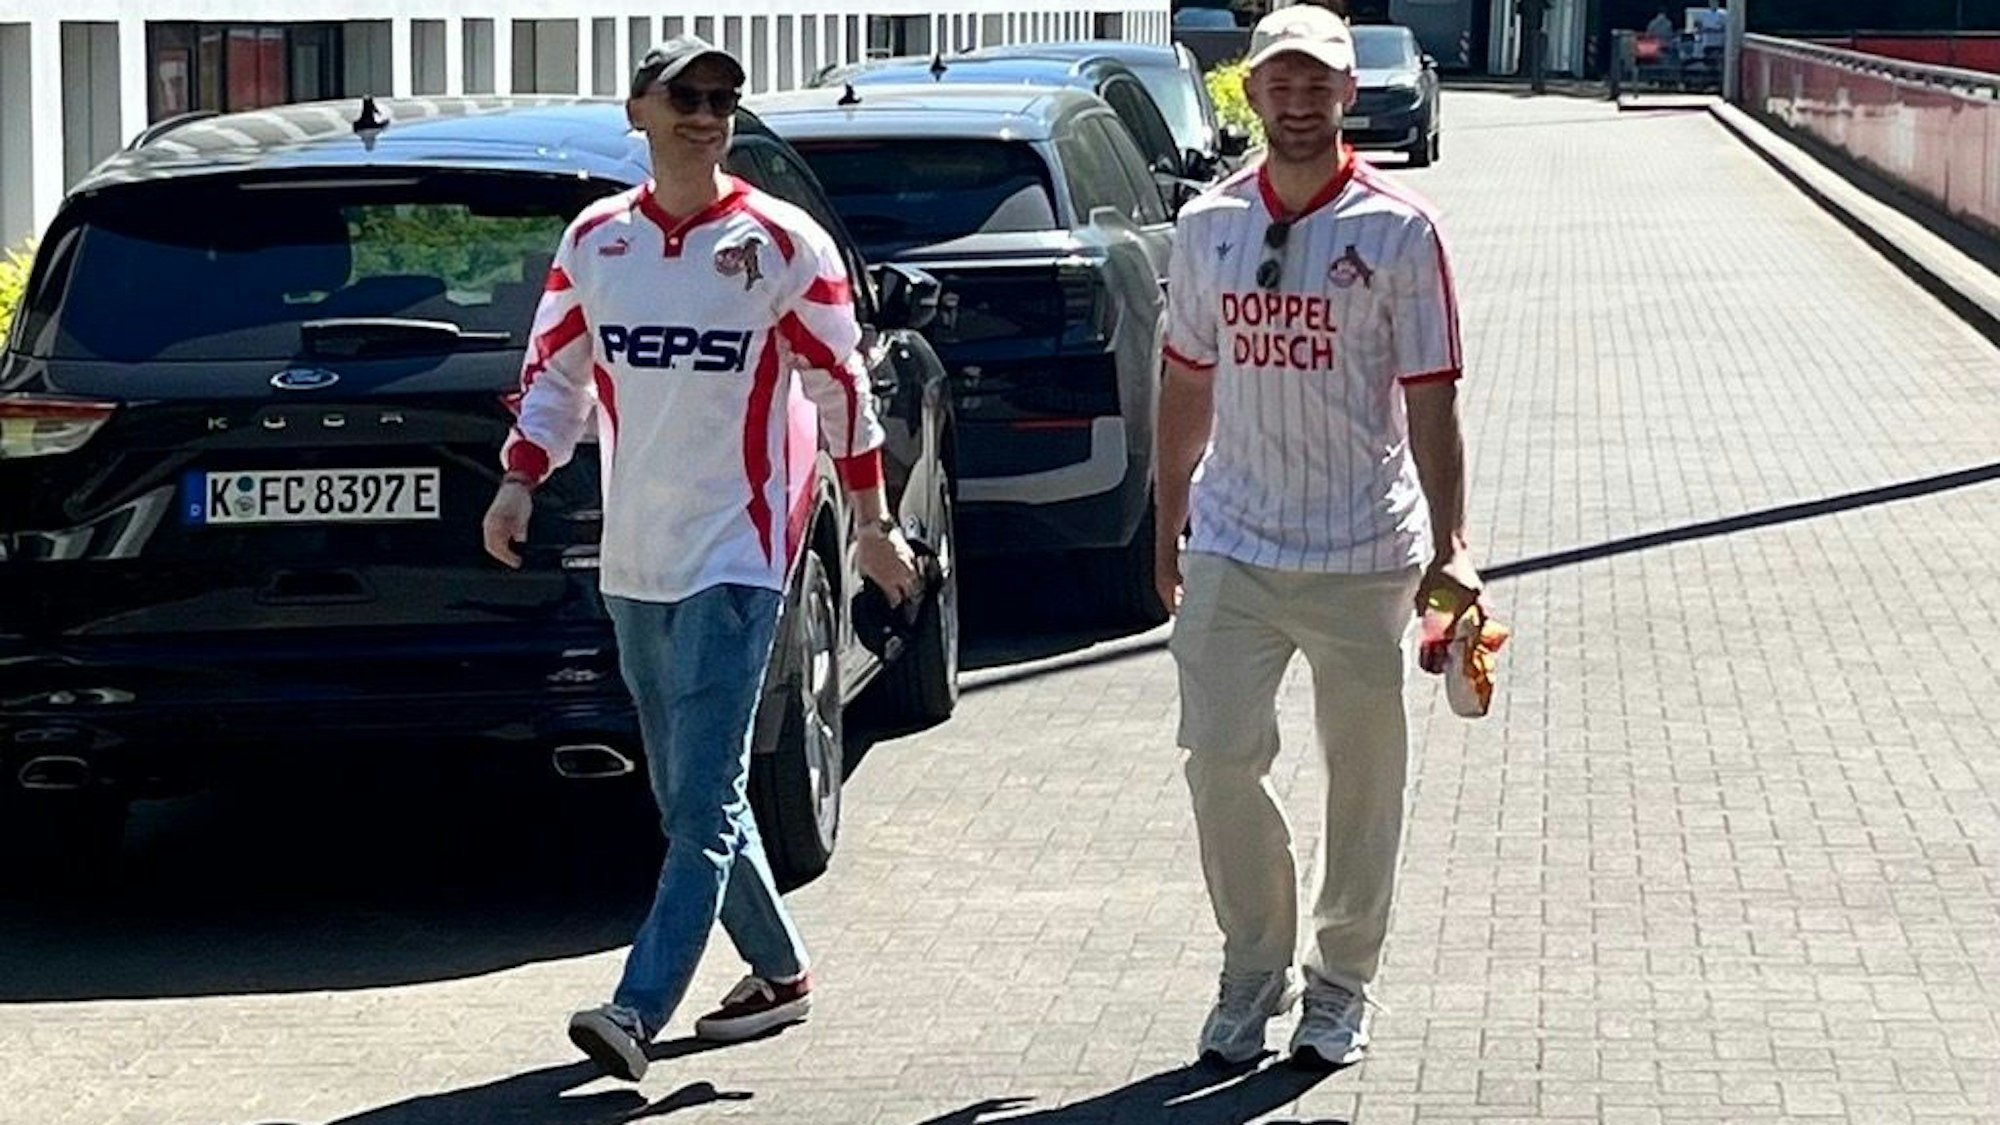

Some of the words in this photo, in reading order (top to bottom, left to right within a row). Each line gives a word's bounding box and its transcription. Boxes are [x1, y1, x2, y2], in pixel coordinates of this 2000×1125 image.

[1222, 292, 1337, 332] DOPPEL
[599, 325, 753, 373] PEPSI
[1234, 332, 1333, 371] DUSCH
[259, 476, 305, 516] FC
